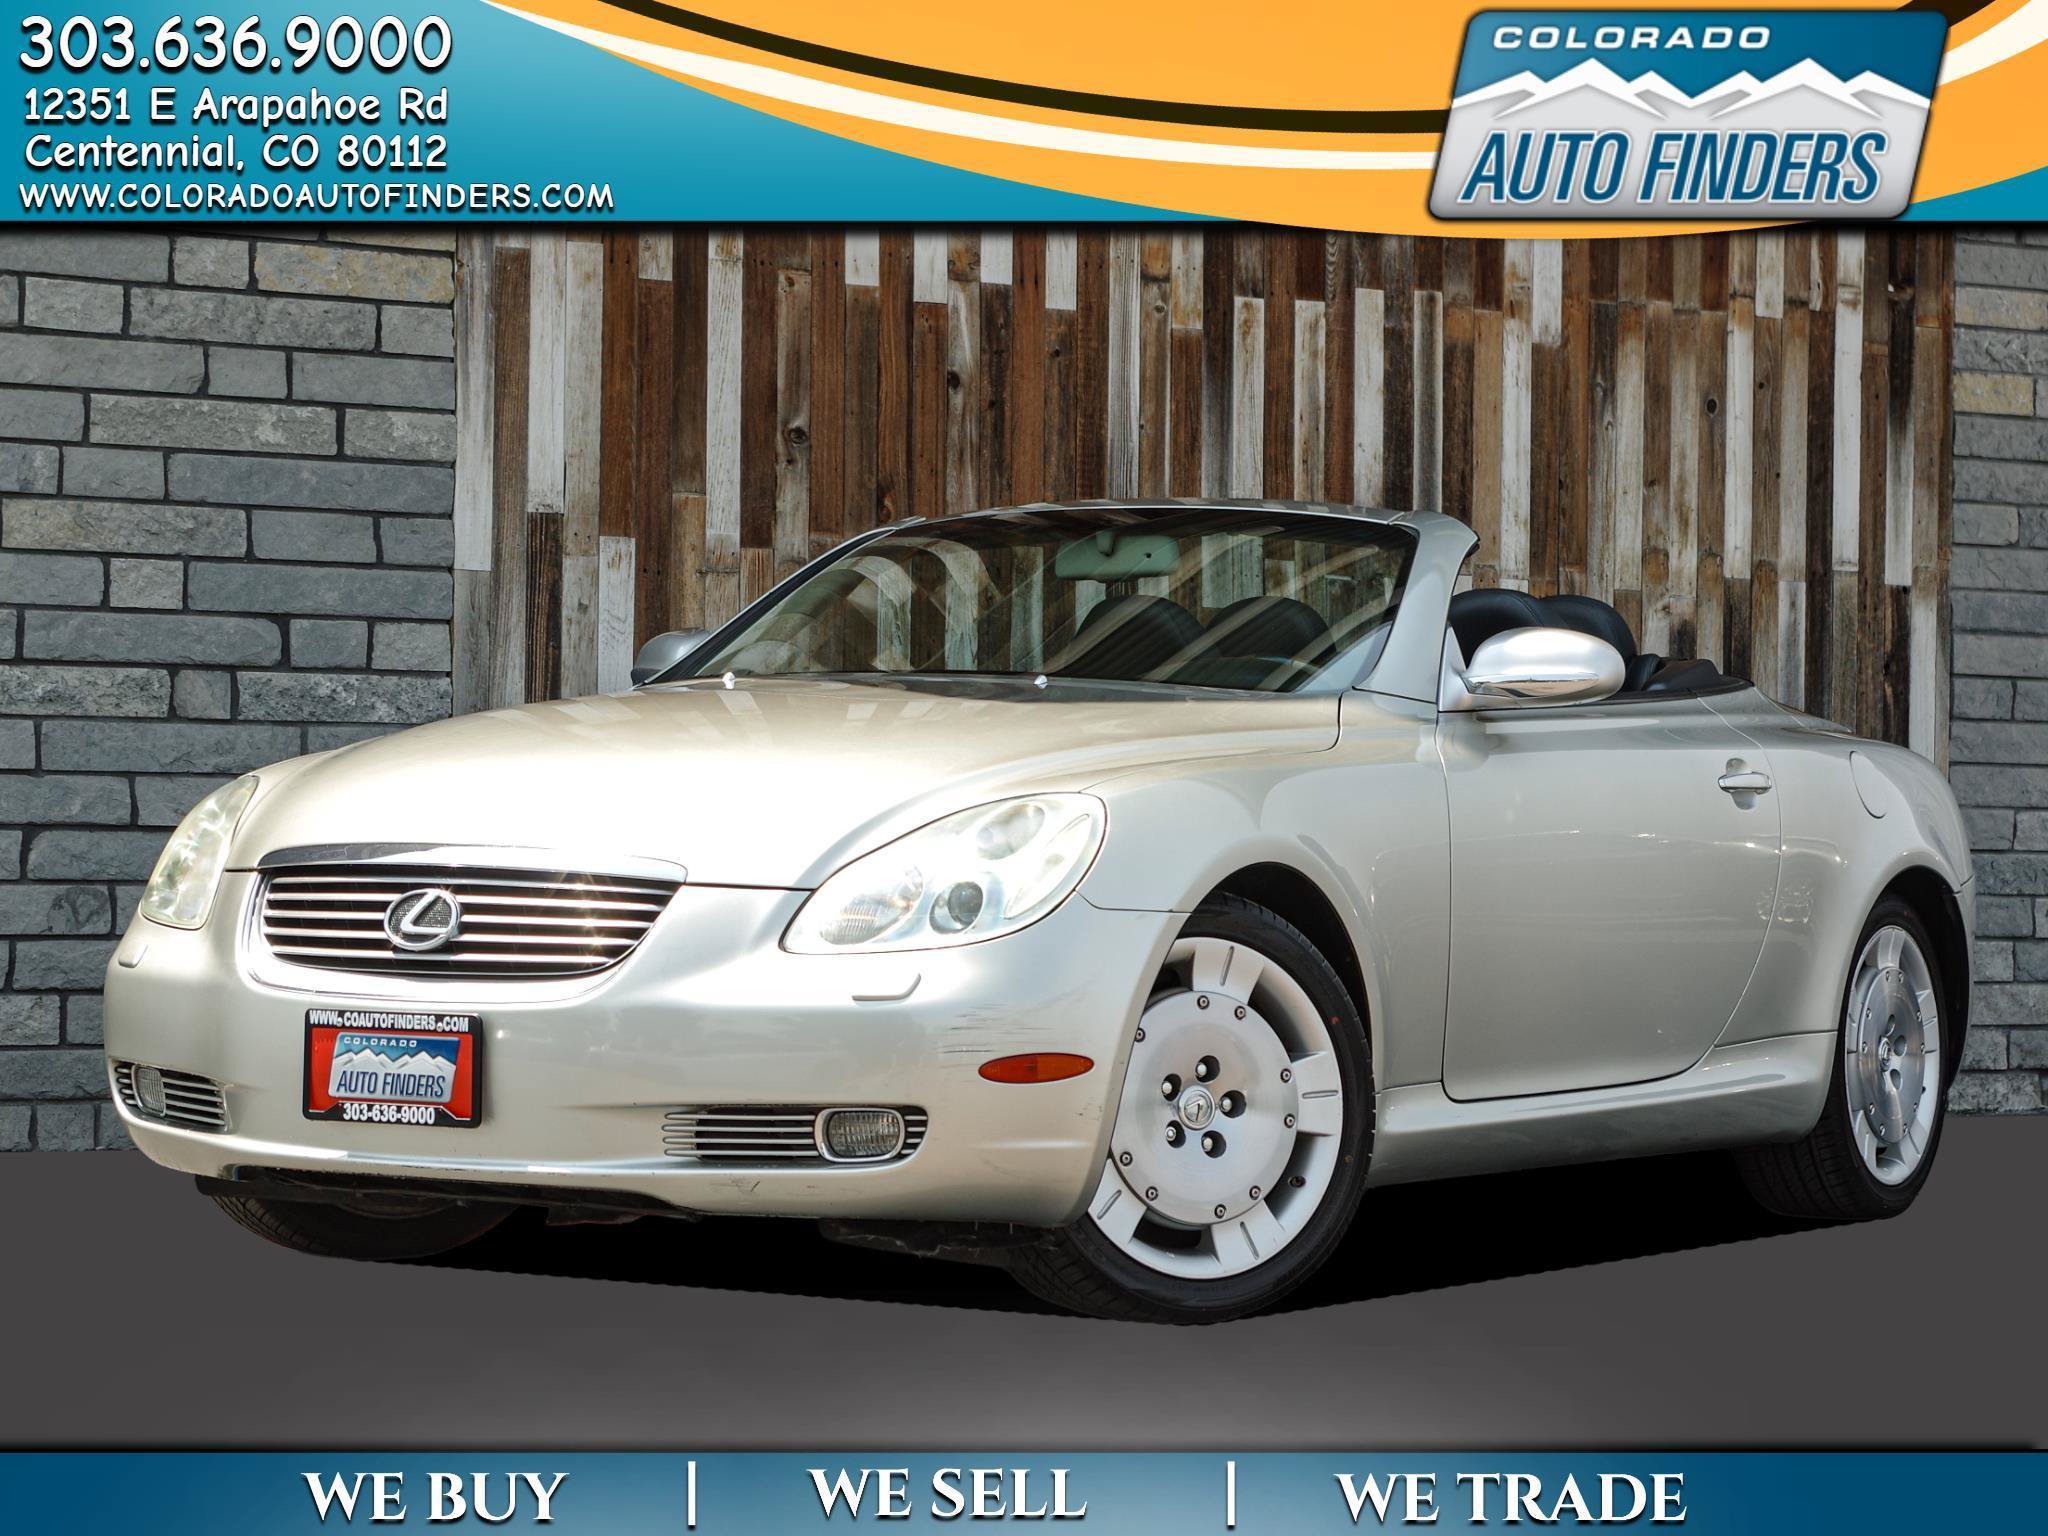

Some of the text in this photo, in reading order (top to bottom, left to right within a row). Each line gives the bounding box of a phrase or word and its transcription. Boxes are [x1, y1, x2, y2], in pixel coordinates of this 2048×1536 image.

[309, 1010, 469, 1032] WWW.COAUTOFINDERS.COM
[343, 1036, 418, 1048] COLORADO
[336, 1070, 446, 1098] AUTO FINDERS
[343, 1103, 436, 1125] 303-636-9000
